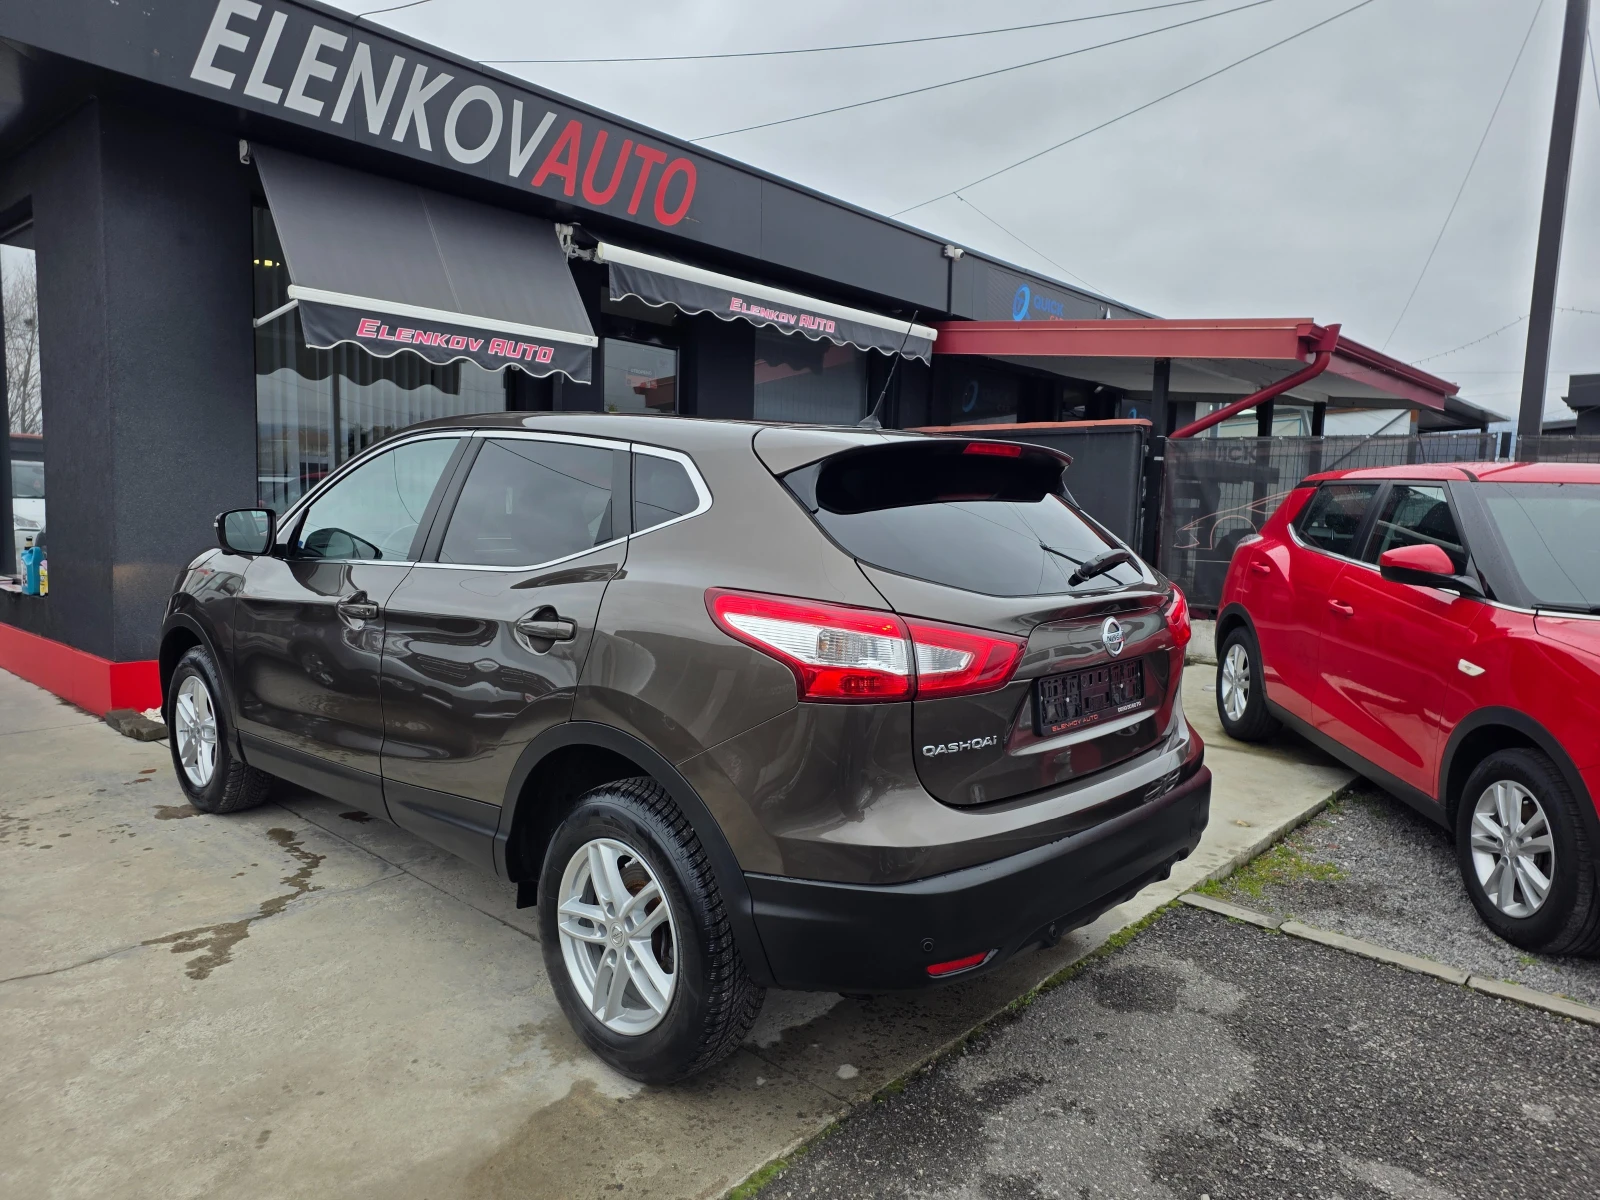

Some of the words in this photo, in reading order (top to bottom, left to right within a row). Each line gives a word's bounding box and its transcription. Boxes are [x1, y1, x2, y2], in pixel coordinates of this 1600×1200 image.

[190, 0, 557, 178] ELENKOV
[531, 120, 698, 227] AUTO
[729, 297, 797, 325] ELENKOV
[798, 313, 836, 333] AUTO
[356, 318, 484, 351] ELENKOV
[488, 337, 555, 364] AUTO
[1083, 713, 1099, 724] AUTO
